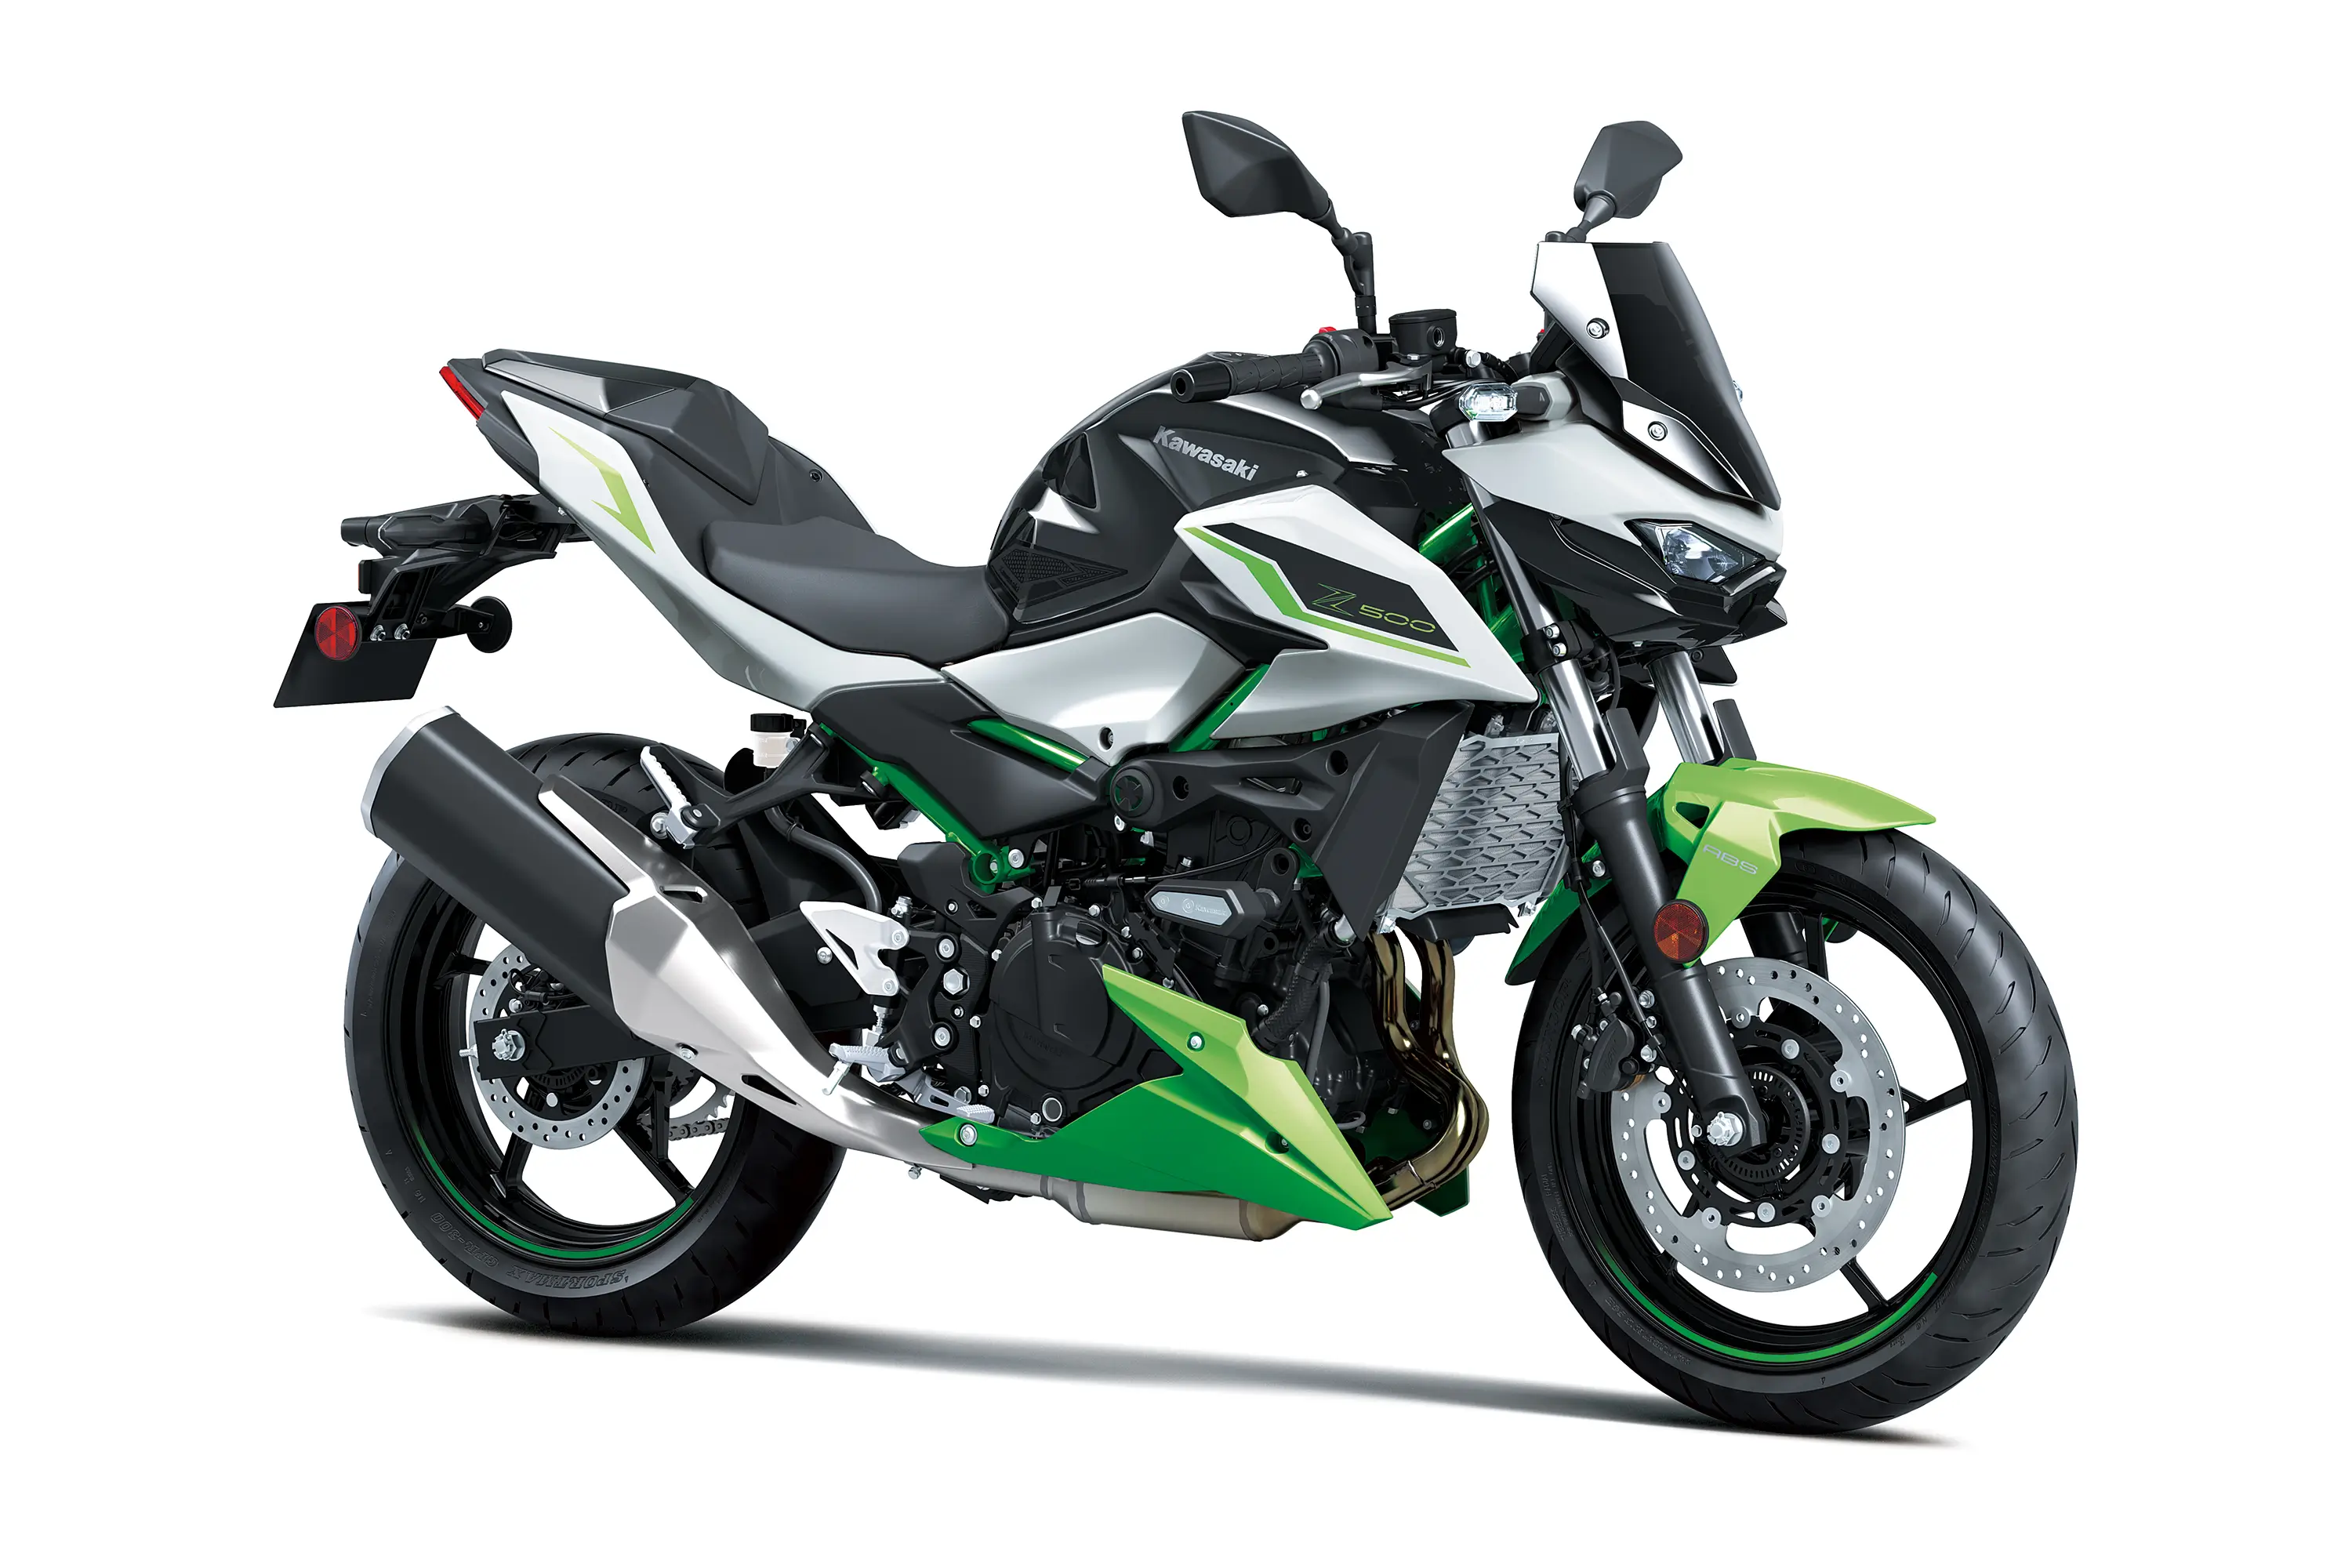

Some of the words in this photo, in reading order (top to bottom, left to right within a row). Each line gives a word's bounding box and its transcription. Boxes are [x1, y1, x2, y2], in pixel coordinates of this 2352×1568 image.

[1152, 425, 1259, 481] Kawasaki
[1358, 604, 1436, 633] 500
[1703, 844, 1759, 875] ABS
[506, 1265, 626, 1290] SPORTMAX
